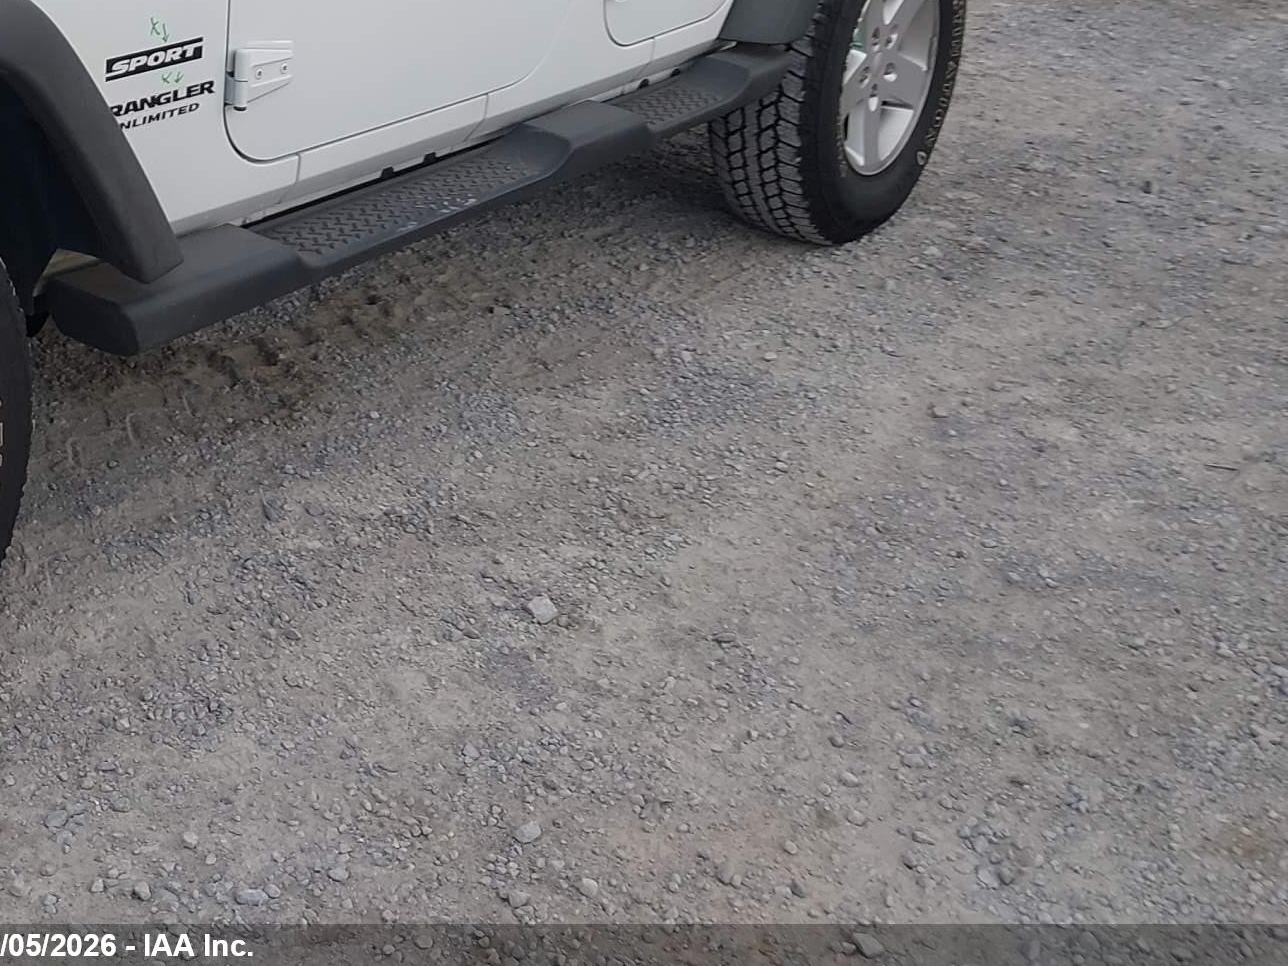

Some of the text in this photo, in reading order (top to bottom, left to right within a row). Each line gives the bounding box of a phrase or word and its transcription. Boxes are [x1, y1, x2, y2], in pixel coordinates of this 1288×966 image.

[112, 44, 197, 73] SPORT
[110, 80, 215, 117] RANGLER
[119, 103, 200, 130] NLIMITED
